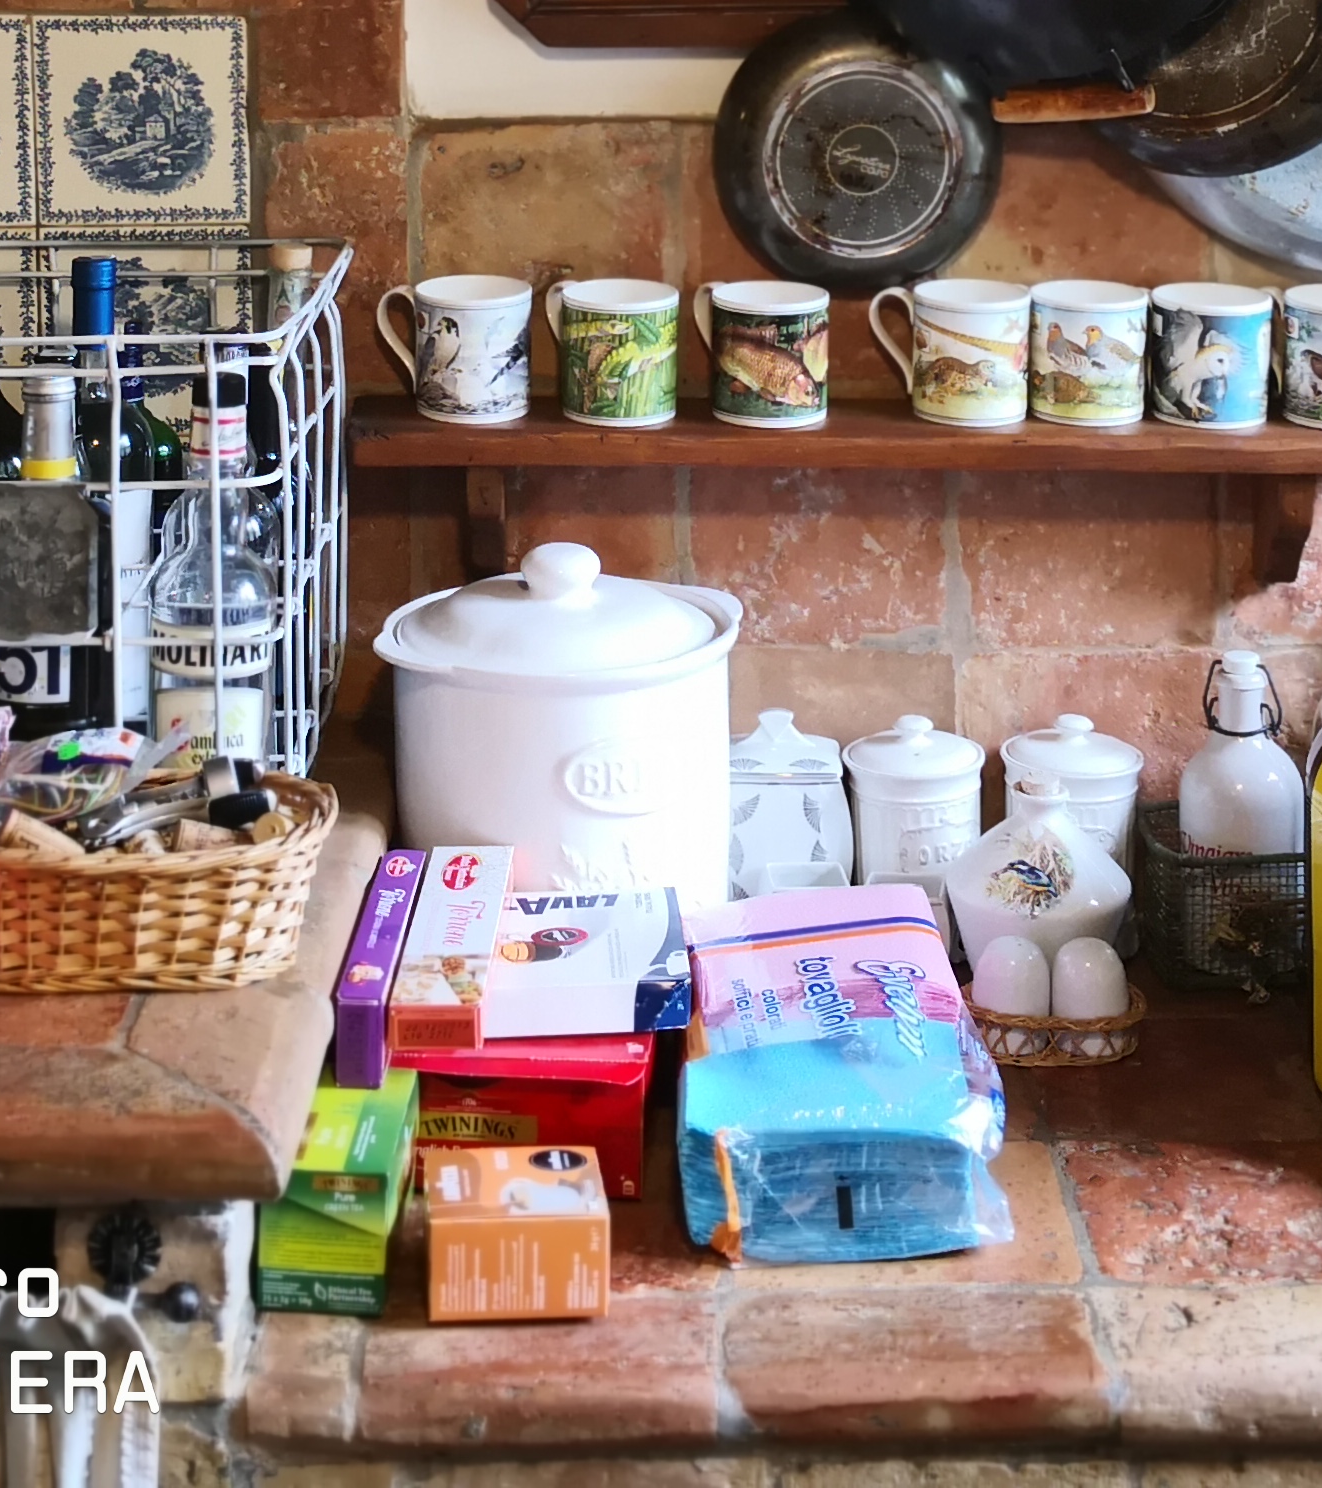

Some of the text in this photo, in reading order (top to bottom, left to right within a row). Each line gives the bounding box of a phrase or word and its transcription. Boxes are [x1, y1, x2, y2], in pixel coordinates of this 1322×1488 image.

[509, 893, 619, 915] LAVA
[797, 956, 863, 1040] tovaglioli
[421, 1115, 517, 1140] TWININGS
[414, 1144, 449, 1157] nglish
